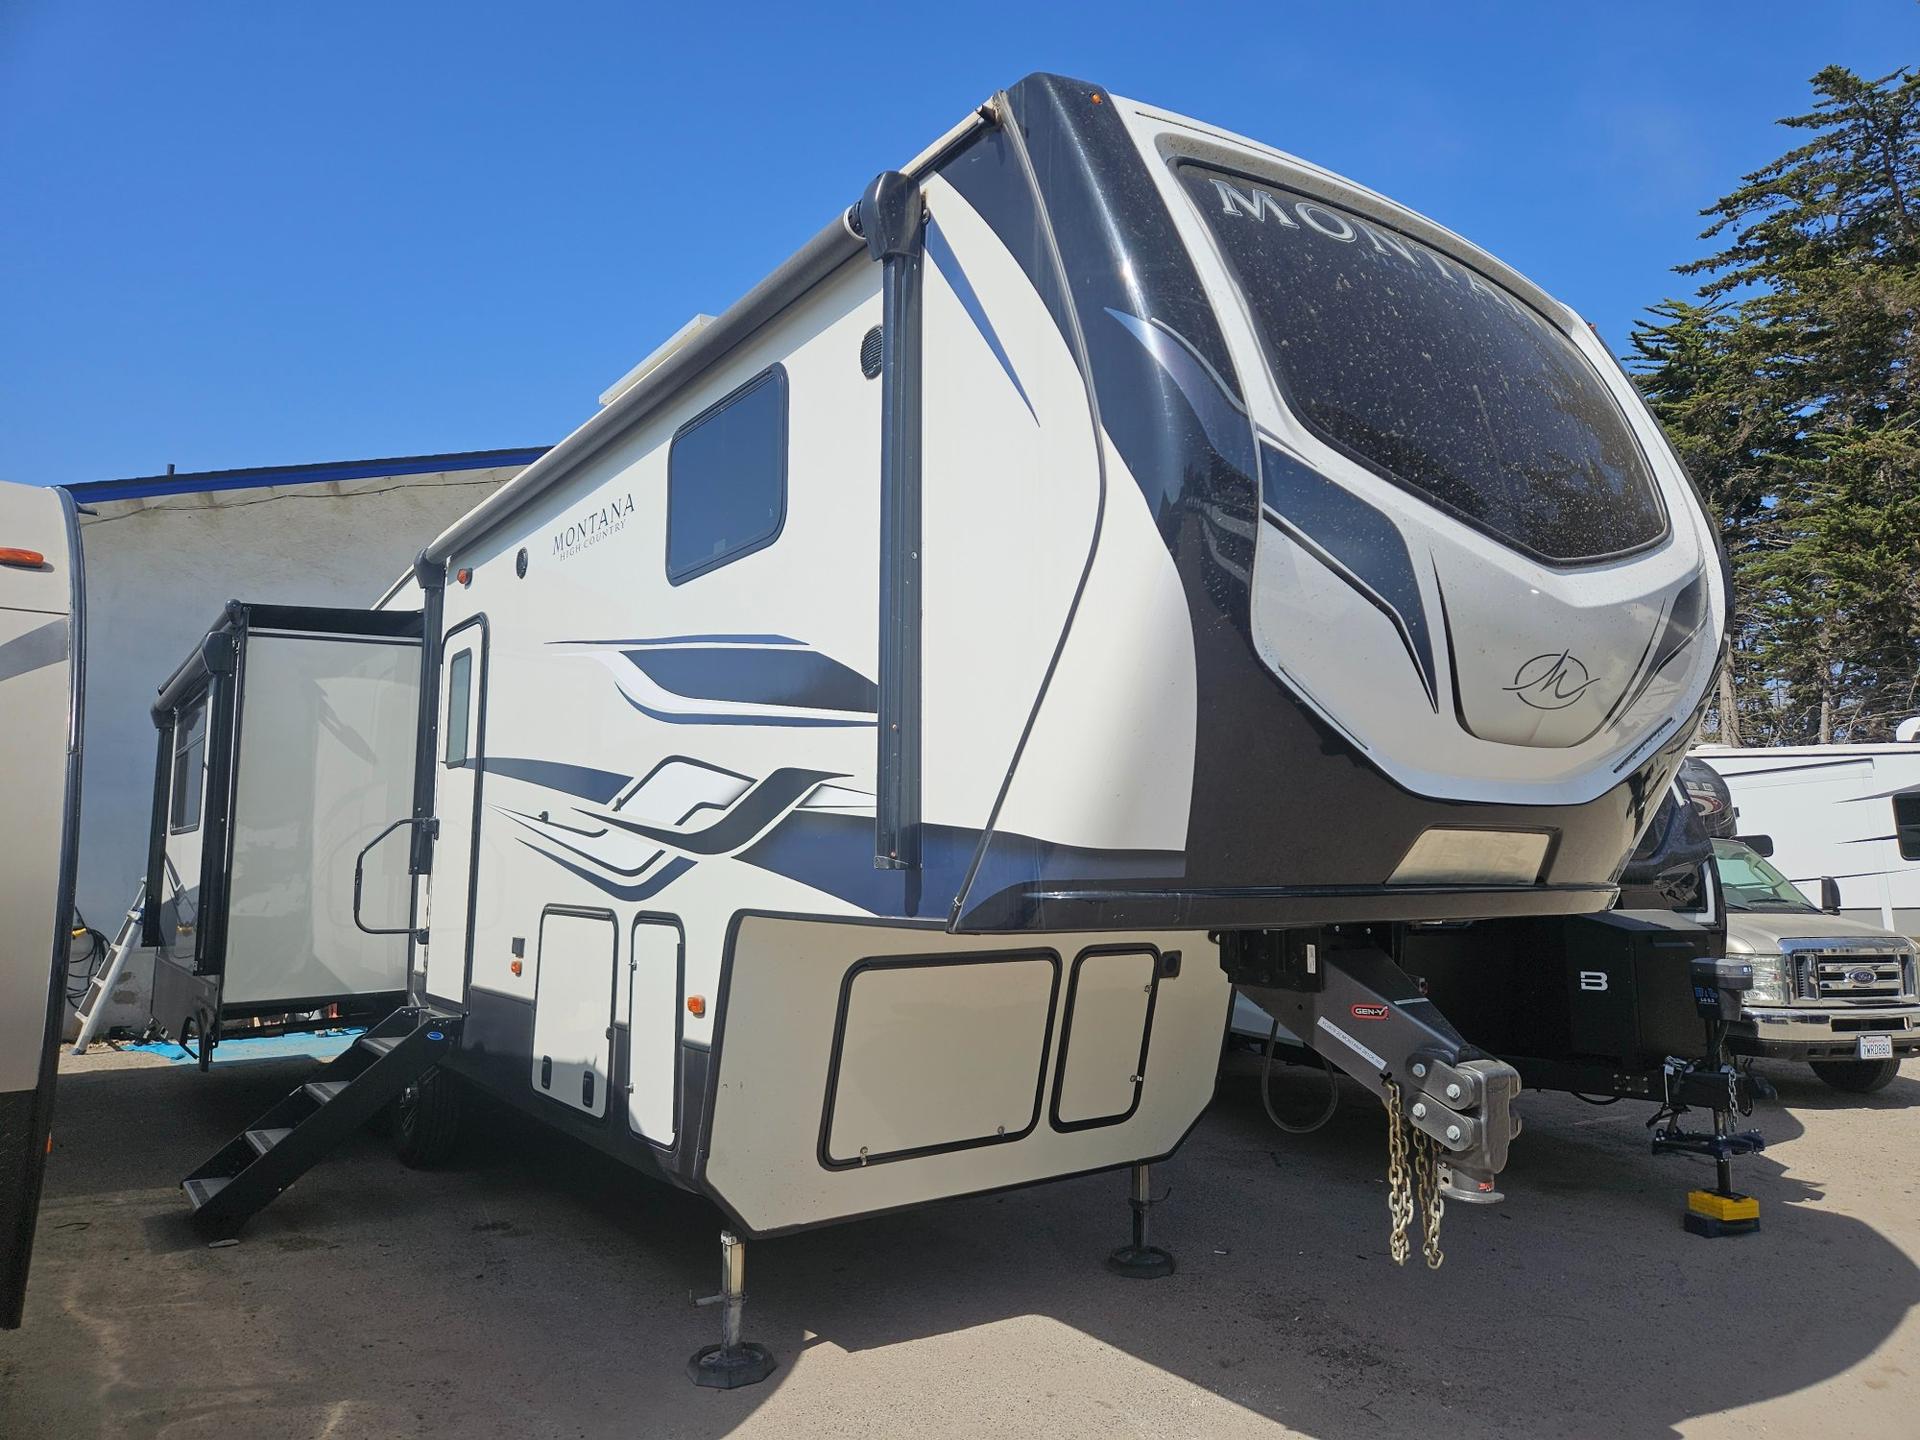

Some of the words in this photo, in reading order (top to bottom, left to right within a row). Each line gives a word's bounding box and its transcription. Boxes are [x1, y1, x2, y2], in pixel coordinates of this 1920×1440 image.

[1209, 178, 1552, 335] MONTA
[552, 493, 635, 556] MONTANA
[560, 543, 581, 561] HIGH
[583, 519, 626, 548] COUNTRY
[1355, 1005, 1388, 1016] GEN-Y
